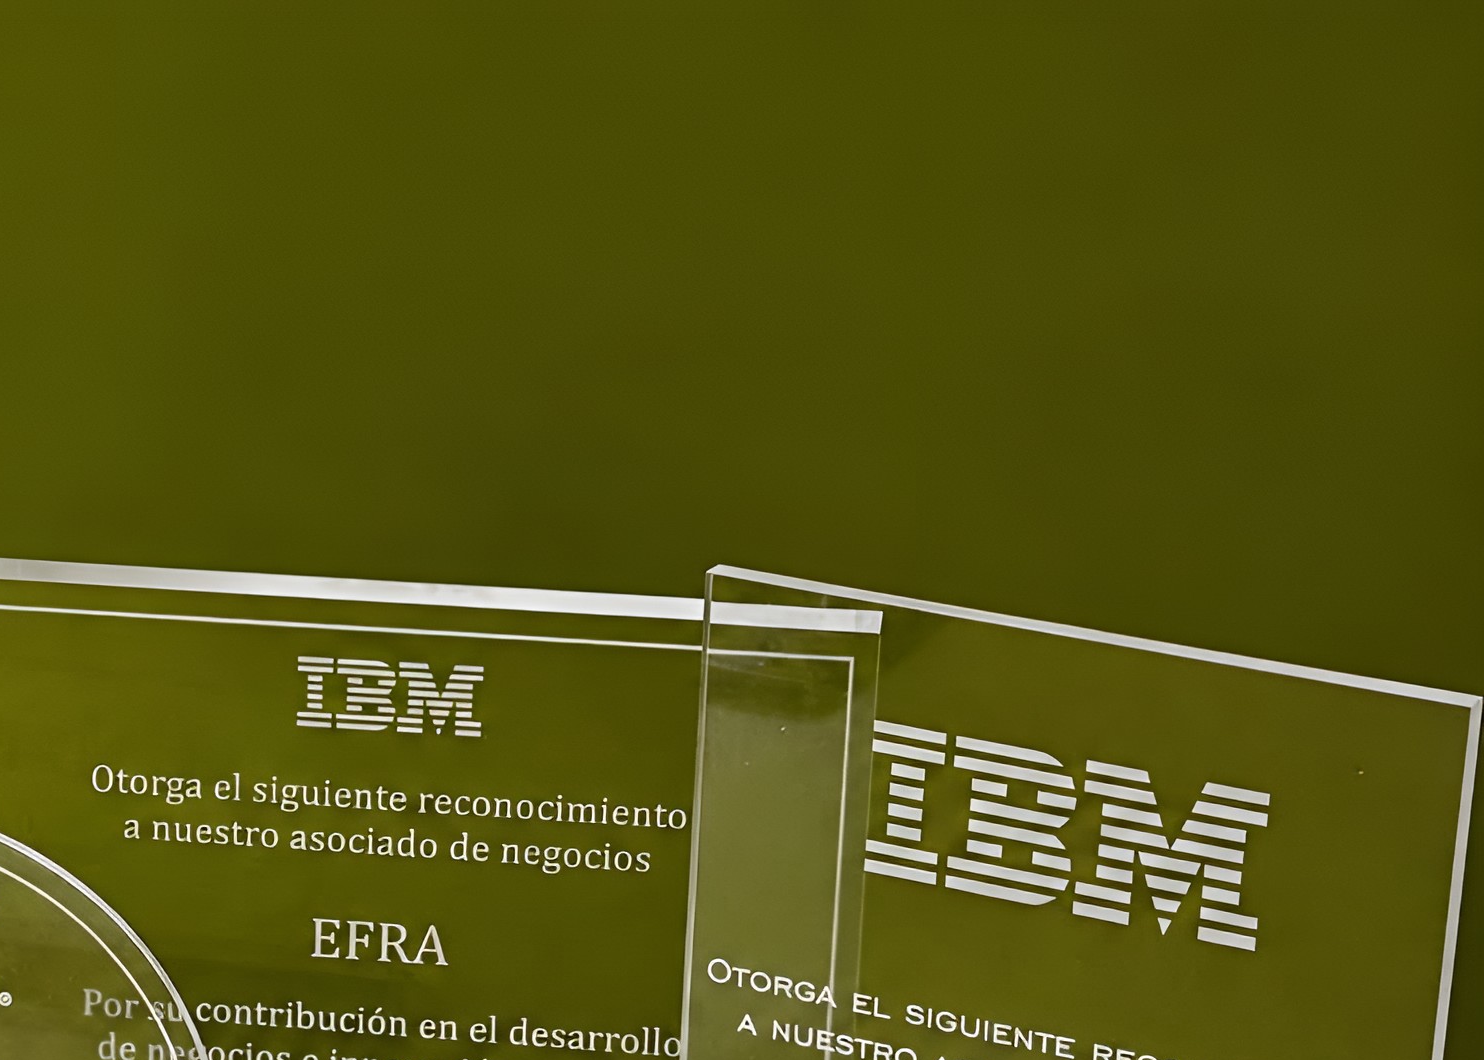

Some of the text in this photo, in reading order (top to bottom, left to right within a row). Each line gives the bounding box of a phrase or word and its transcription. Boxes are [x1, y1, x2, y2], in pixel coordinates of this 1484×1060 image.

[296, 655, 485, 738] IBM
[90, 764, 688, 830] Otorga el siguiente reconocimiento
[123, 818, 652, 875] a nuestro asociado de negocios
[863, 719, 1272, 952] IBM
[310, 917, 450, 967] EFRA
[82, 988, 682, 1058] Por su contribución en el desarrollo
[736, 1013, 758, 1038] A
[852, 991, 892, 1021] EL
[904, 1004, 1077, 1060] SIGUIENTE
